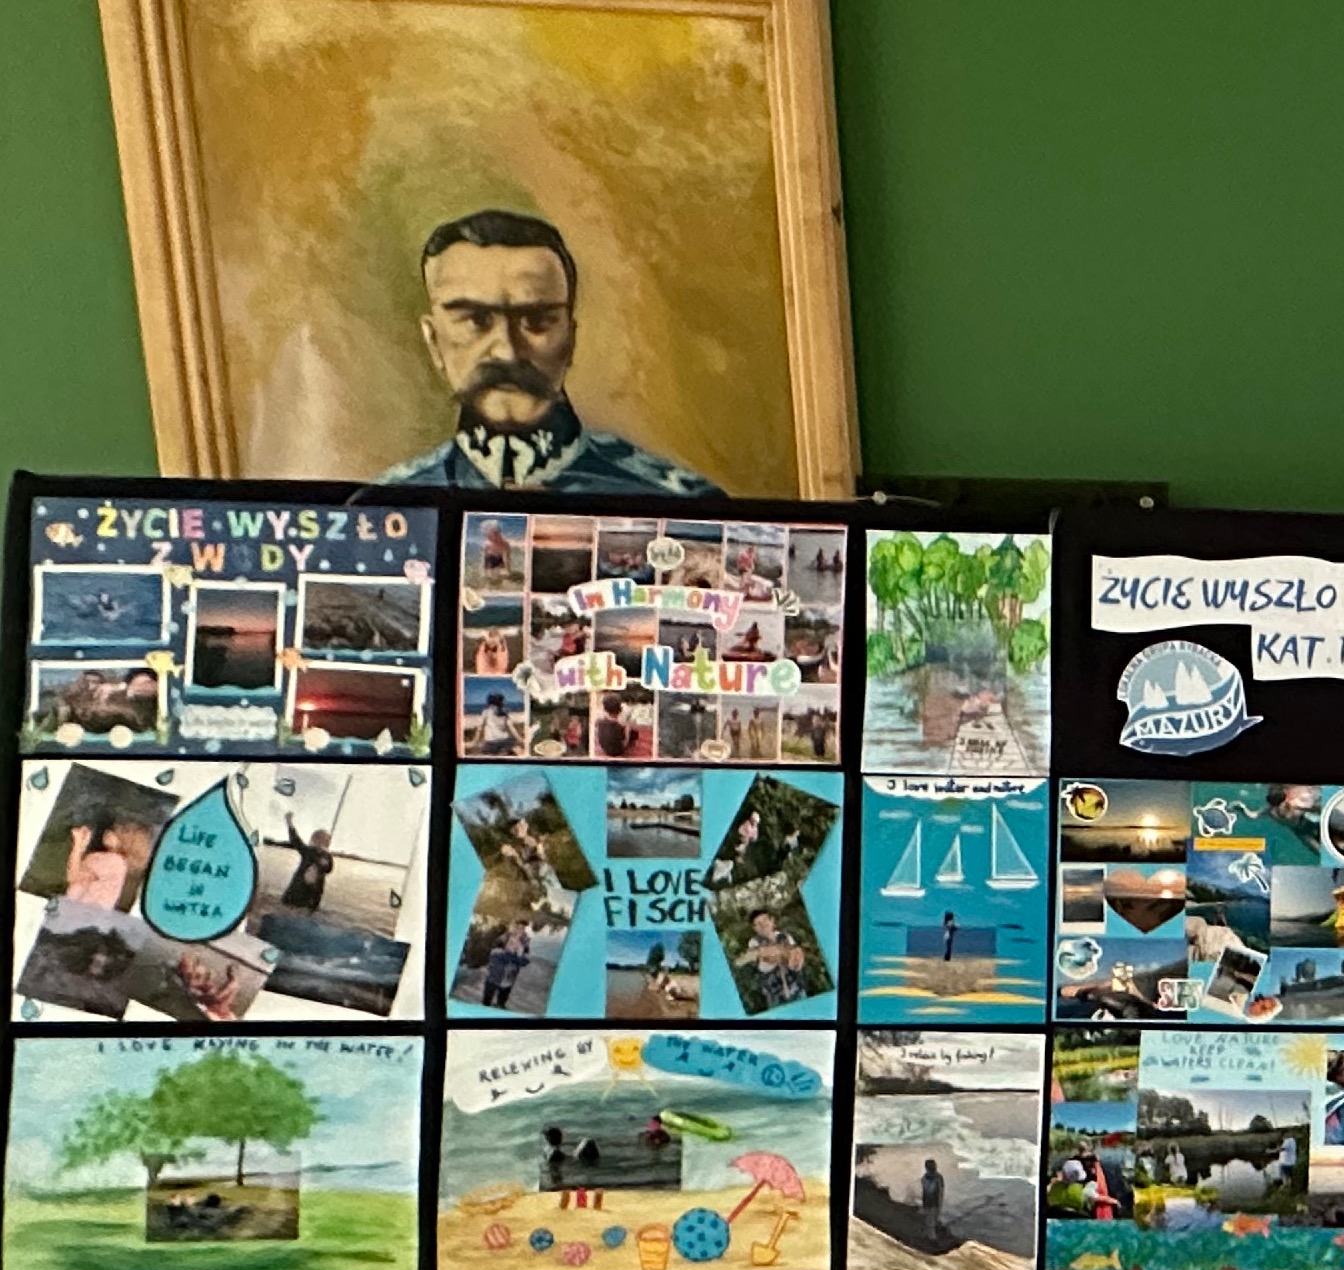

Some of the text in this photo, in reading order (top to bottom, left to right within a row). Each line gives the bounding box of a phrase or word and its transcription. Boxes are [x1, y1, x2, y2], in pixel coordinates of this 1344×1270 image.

[97, 500, 206, 540] ŻYCIE
[150, 541, 173, 568] Z
[612, 580, 742, 628] Harmony
[1099, 568, 1193, 611] ŻYCIE
[1202, 577, 1337, 613] WYSZŁO
[556, 646, 799, 694] with Nature
[1133, 695, 1237, 738] MAZURY
[903, 779, 929, 792] love
[163, 855, 231, 878] BEGAN
[603, 867, 703, 895] I LOVE
[603, 896, 706, 927] FISCH
[1215, 1033, 1280, 1045] NATURE
